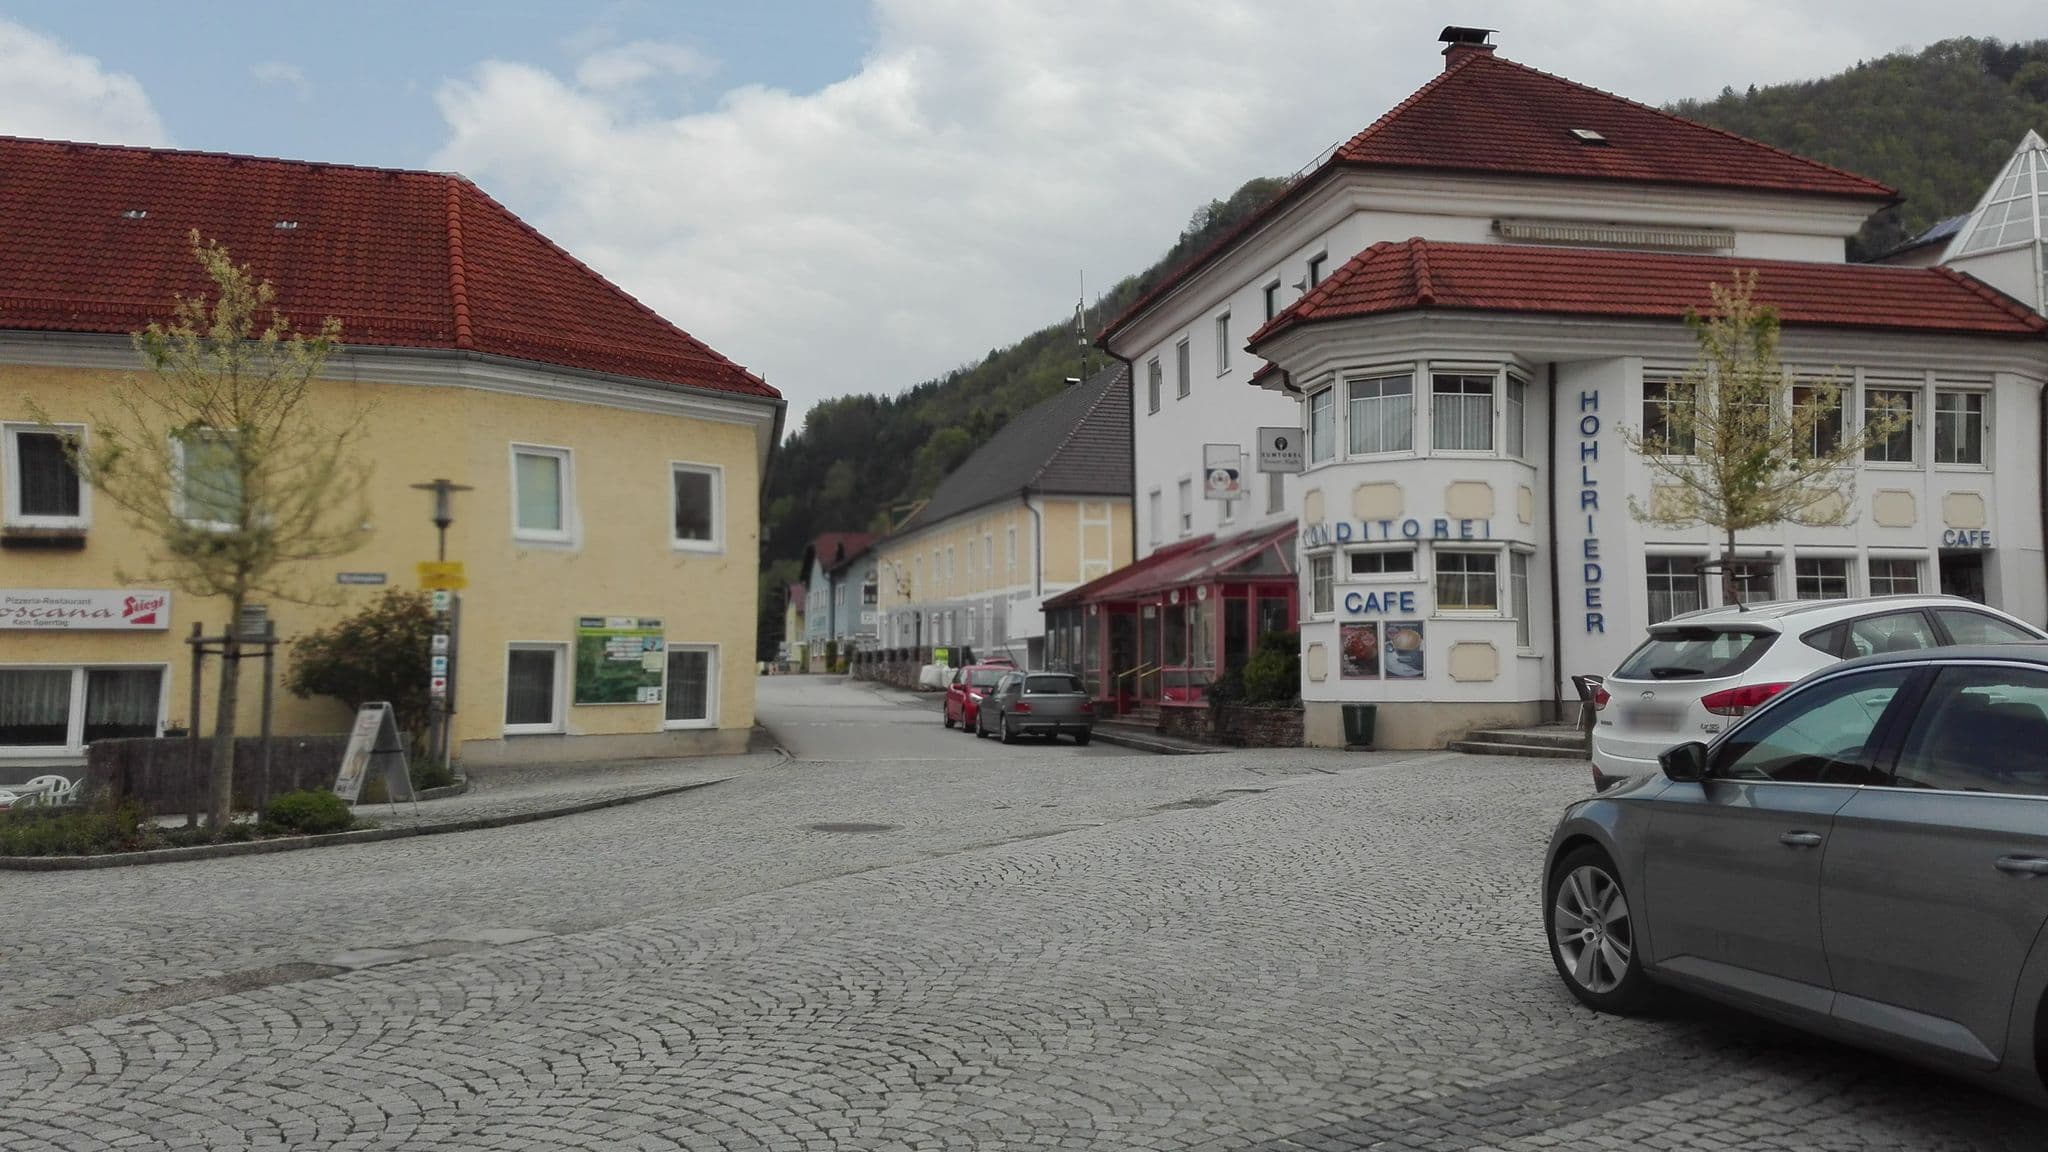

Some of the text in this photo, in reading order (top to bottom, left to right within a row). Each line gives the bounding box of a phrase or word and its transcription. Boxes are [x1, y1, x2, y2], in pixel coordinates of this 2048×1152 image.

[1580, 389, 1604, 634] HOHLRIEDER
[1943, 529, 1991, 547] CAFE
[122, 595, 164, 618] Stiegl
[1344, 590, 1415, 615] CAFE
